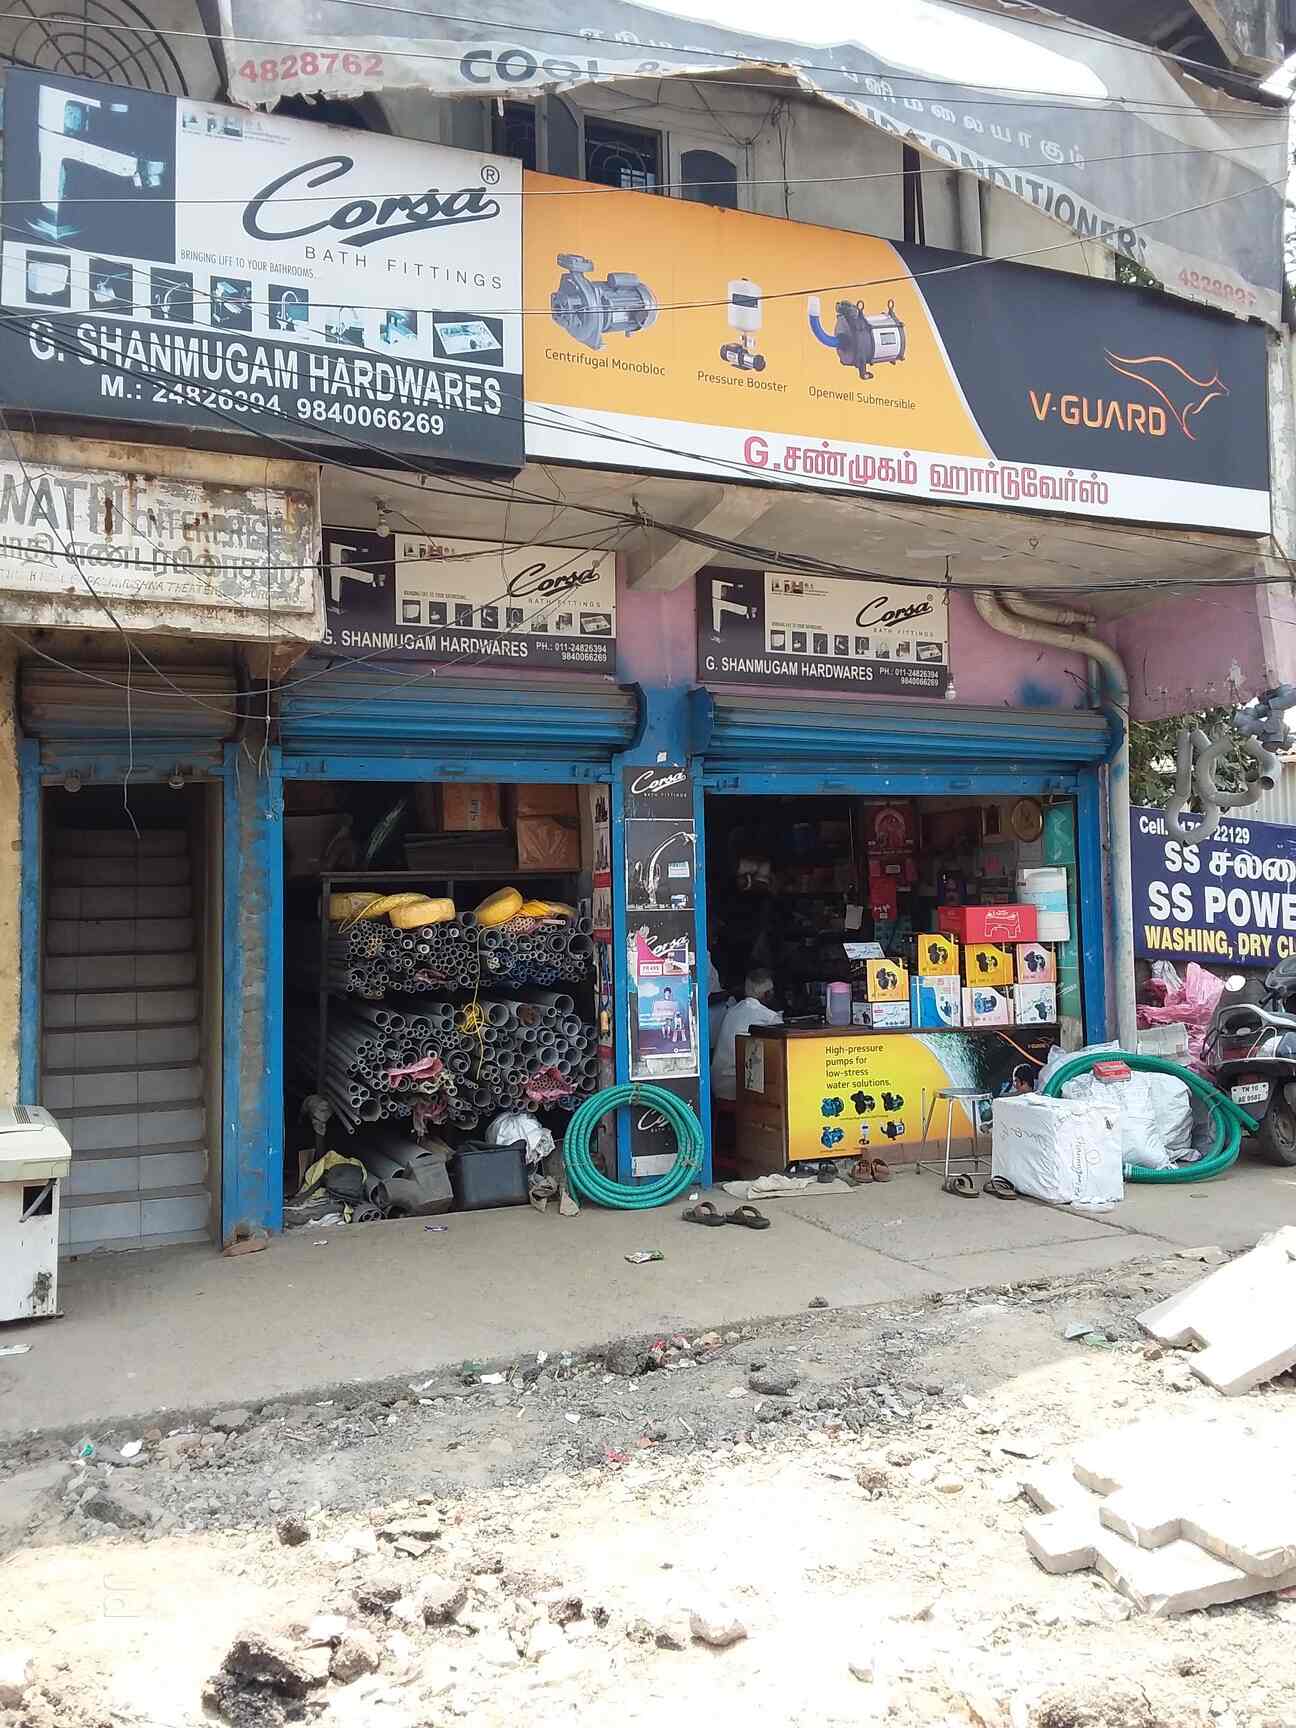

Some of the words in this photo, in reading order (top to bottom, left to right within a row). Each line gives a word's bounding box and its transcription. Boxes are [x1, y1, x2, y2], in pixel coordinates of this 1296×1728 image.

[239, 52, 384, 82] 4828762
[180, 249, 217, 264] BRINGING
[218, 254, 233, 267] LIFE
[235, 257, 245, 268] TO
[248, 259, 267, 272] YOUR
[305, 246, 367, 268] BATH
[387, 258, 502, 290] FITTINGS
[28, 316, 65, 363] G.
[76, 323, 299, 391] SHANMUGAM
[309, 354, 502, 416] HARDWARES
[545, 349, 609, 371] Centrifugal
[611, 358, 666, 377] Monobloc
[697, 370, 744, 388] Pressure
[746, 377, 788, 393] Booster
[808, 386, 854, 403] Openwell
[856, 391, 916, 410] Submersible
[298, 398, 445, 436] 9840066269
[341, 630, 436, 651] SHANMUGAM
[440, 636, 529, 657] HARDWARES
[705, 656, 719, 671] G.
[721, 658, 799, 676] SHANMUGAM
[800, 662, 874, 682] HARDWARES
[1138, 815, 1169, 837] Cell.
[1164, 839, 1201, 874] SS
[1148, 880, 1194, 923] SS
[1144, 924, 1234, 960] WASHING,
[1237, 932, 1273, 957] DRY
[825, 1044, 884, 1056] High-pressure
[825, 1056, 854, 1068] pumps
[856, 1056, 868, 1065] for
[826, 1068, 869, 1078] low-stress
[826, 1080, 850, 1089] water
